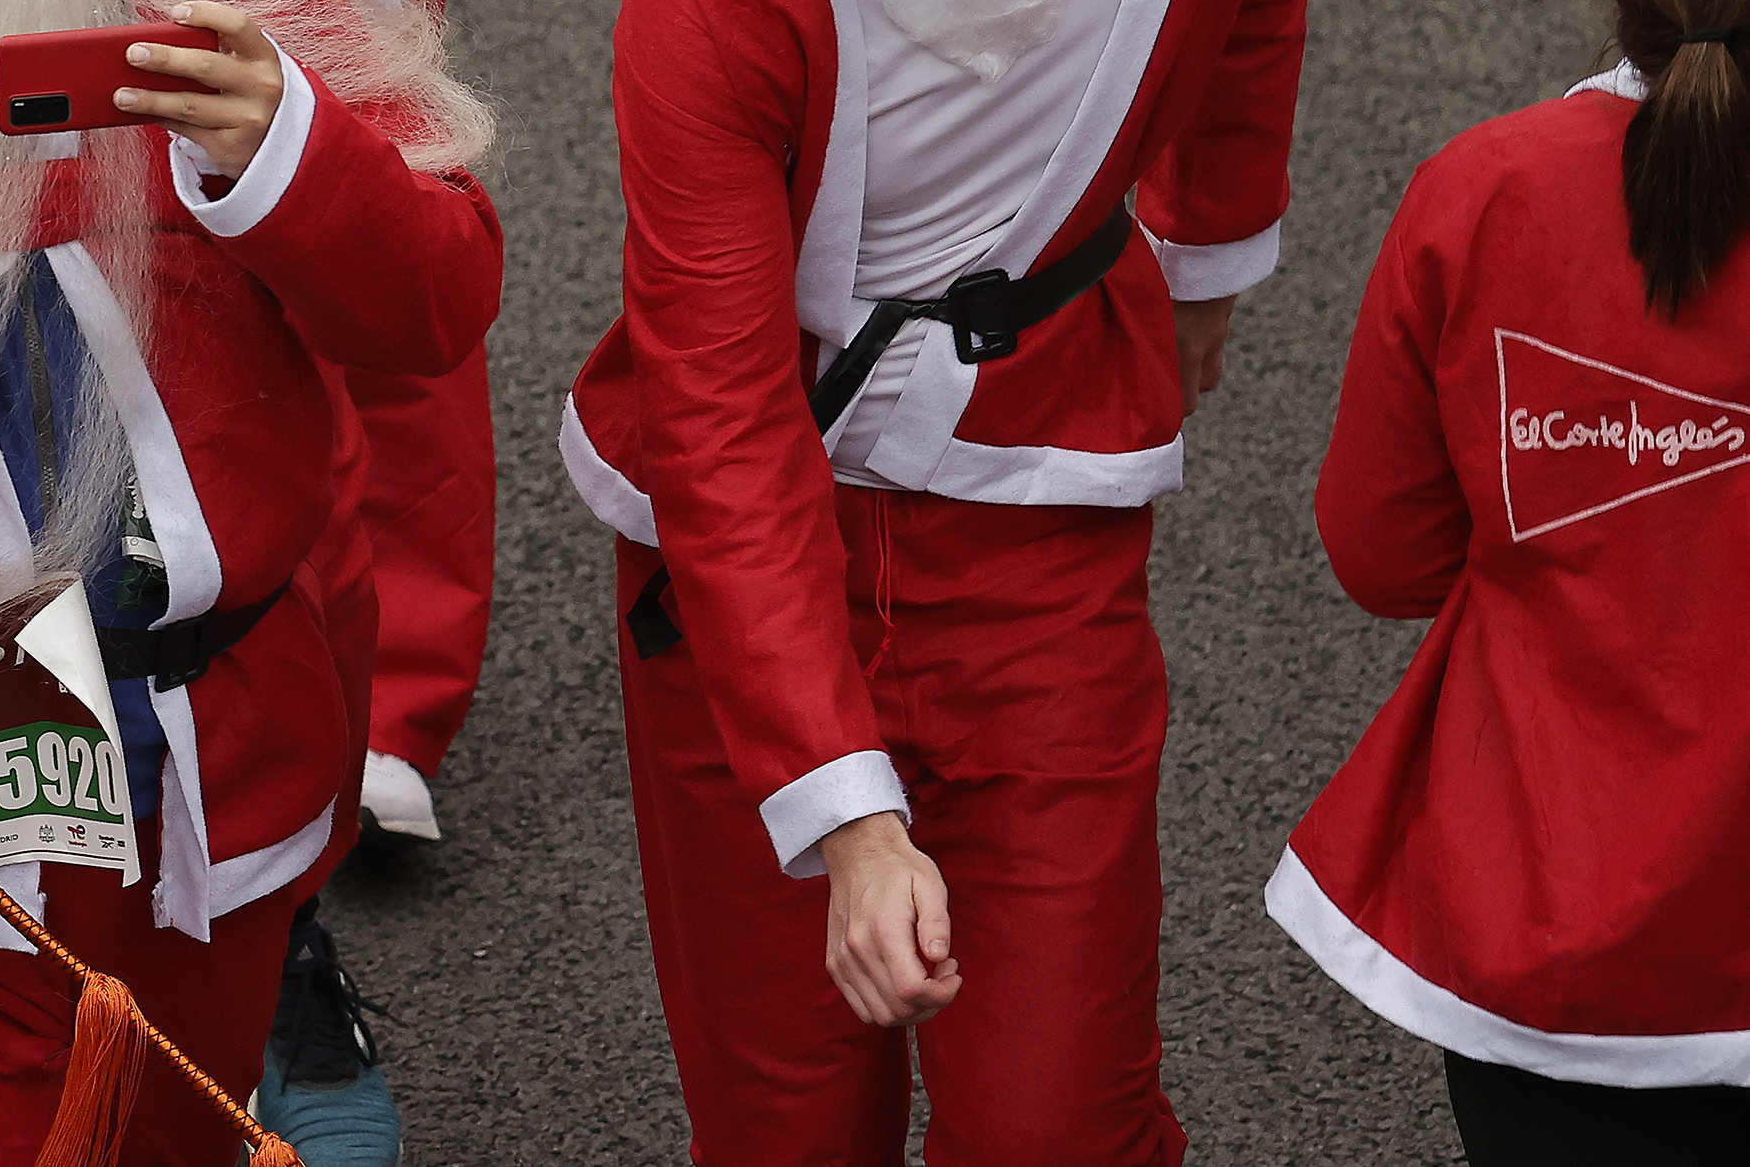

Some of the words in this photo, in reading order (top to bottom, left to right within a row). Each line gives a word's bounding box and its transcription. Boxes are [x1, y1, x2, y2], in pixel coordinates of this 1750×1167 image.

[1510, 407, 1543, 451] El
[1542, 410, 1626, 451] Corte
[1627, 399, 1746, 467] Inglés
